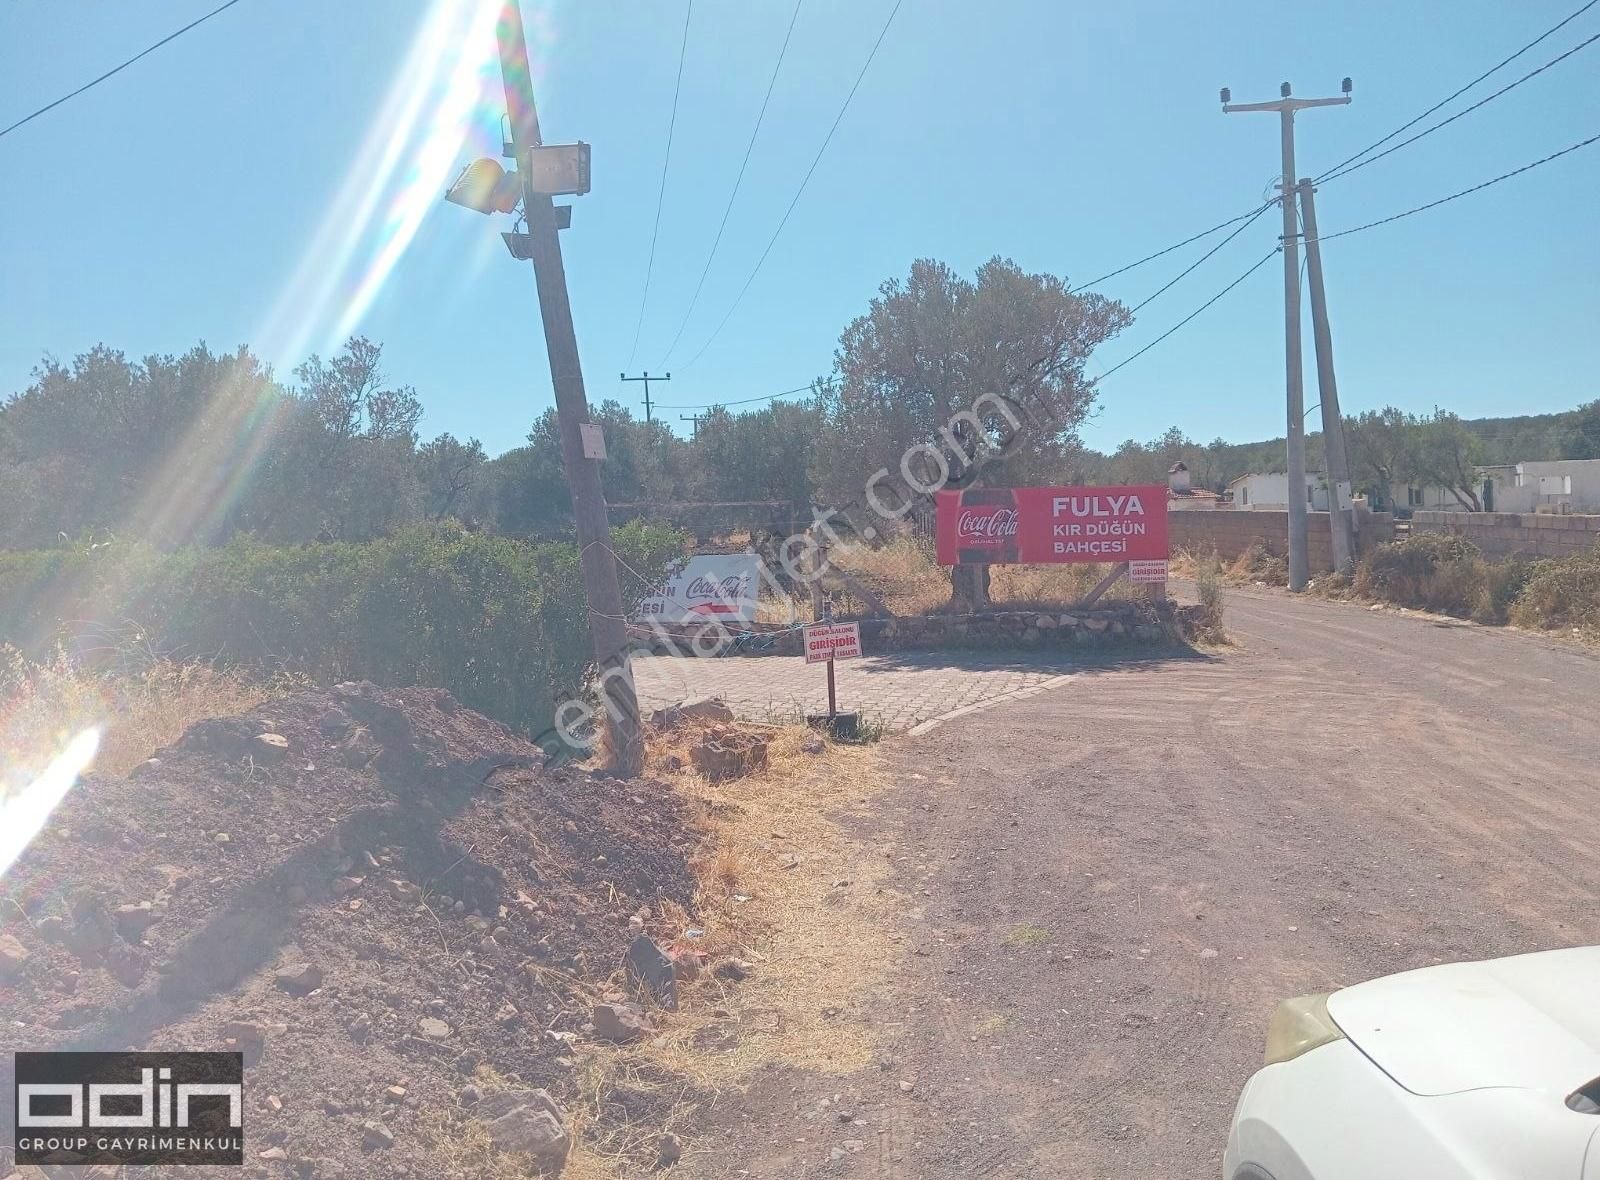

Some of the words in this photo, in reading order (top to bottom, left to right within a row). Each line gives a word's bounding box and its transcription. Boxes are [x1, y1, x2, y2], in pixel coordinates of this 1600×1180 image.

[1053, 496, 1145, 517] FULYA
[1053, 524, 1081, 536] KIR
[1086, 520, 1145, 536] DÜĞÜN
[1054, 538, 1127, 556] BAHÇESİ
